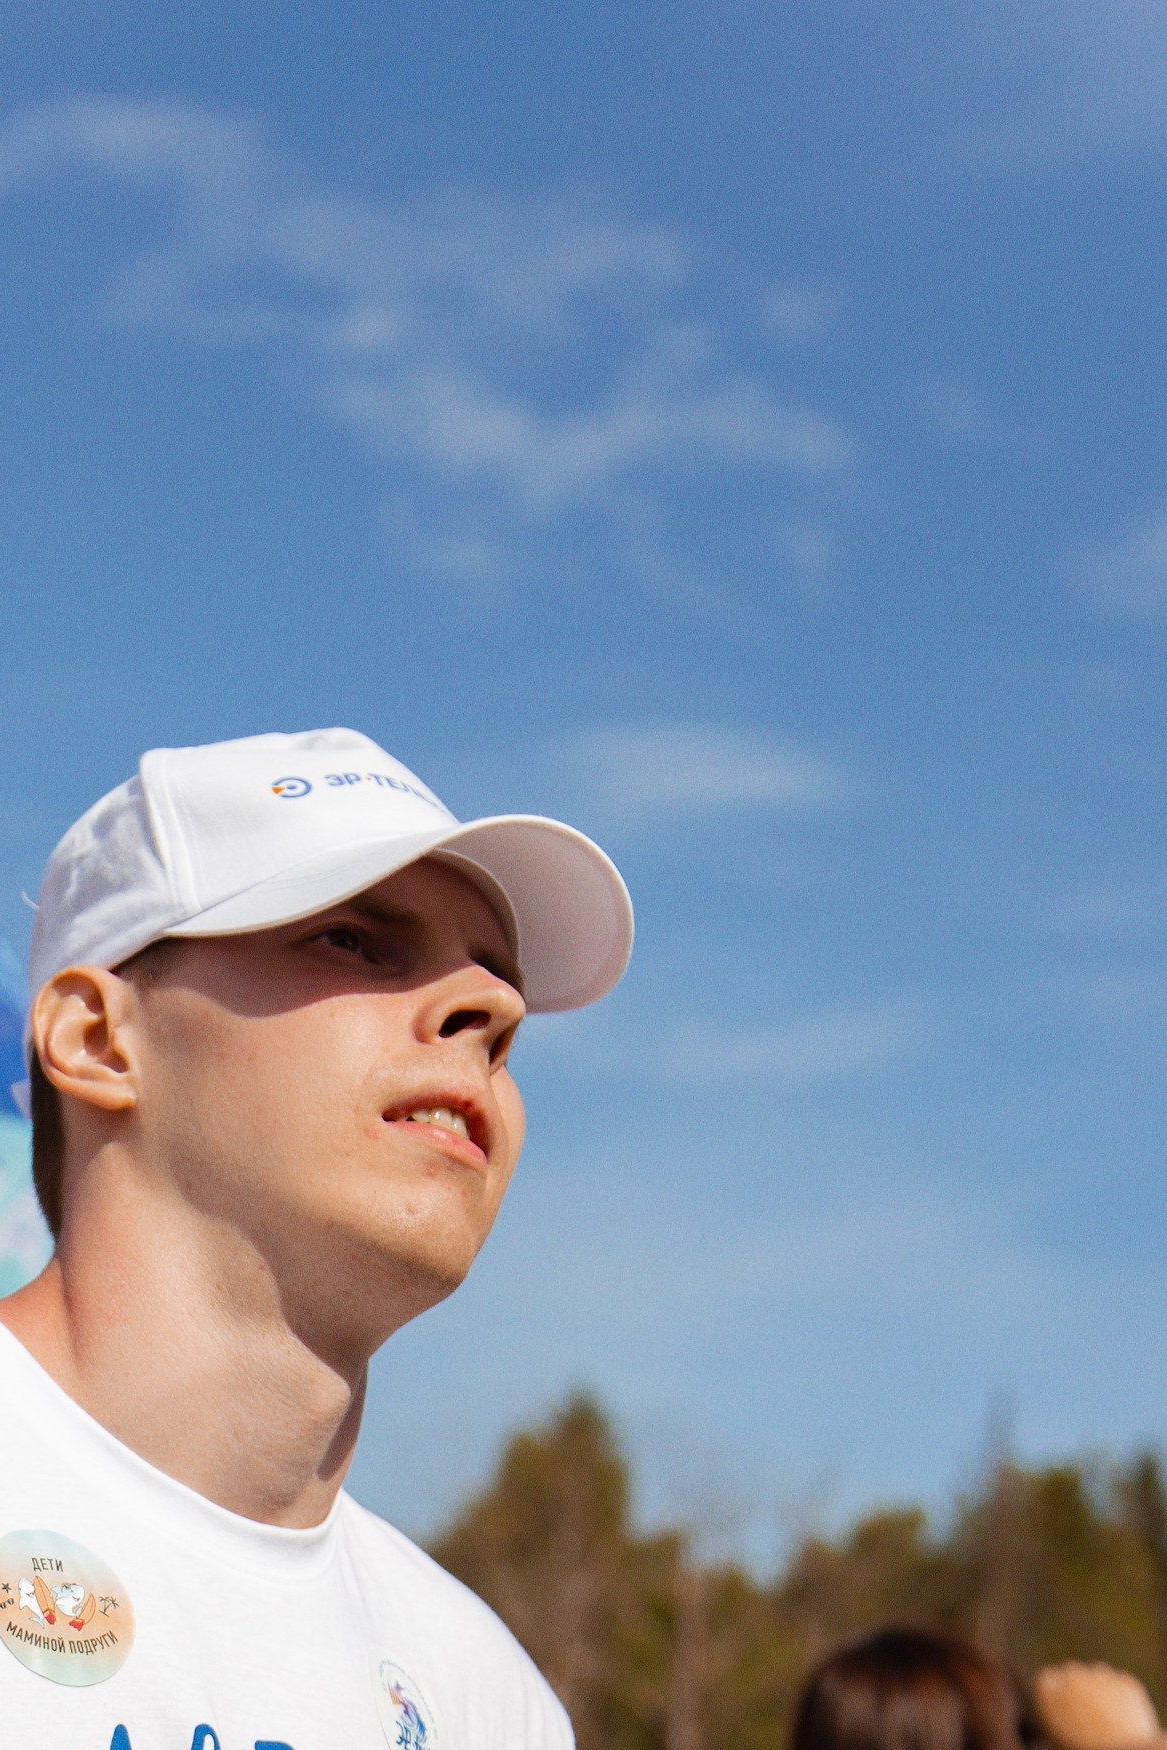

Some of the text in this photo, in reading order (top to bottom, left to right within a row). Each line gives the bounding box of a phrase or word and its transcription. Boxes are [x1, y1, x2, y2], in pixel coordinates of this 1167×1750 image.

[31, 1557, 64, 1572] ДЕТИ
[6, 1620, 119, 1656] МАМИНОЙ ПОДРУГИ
